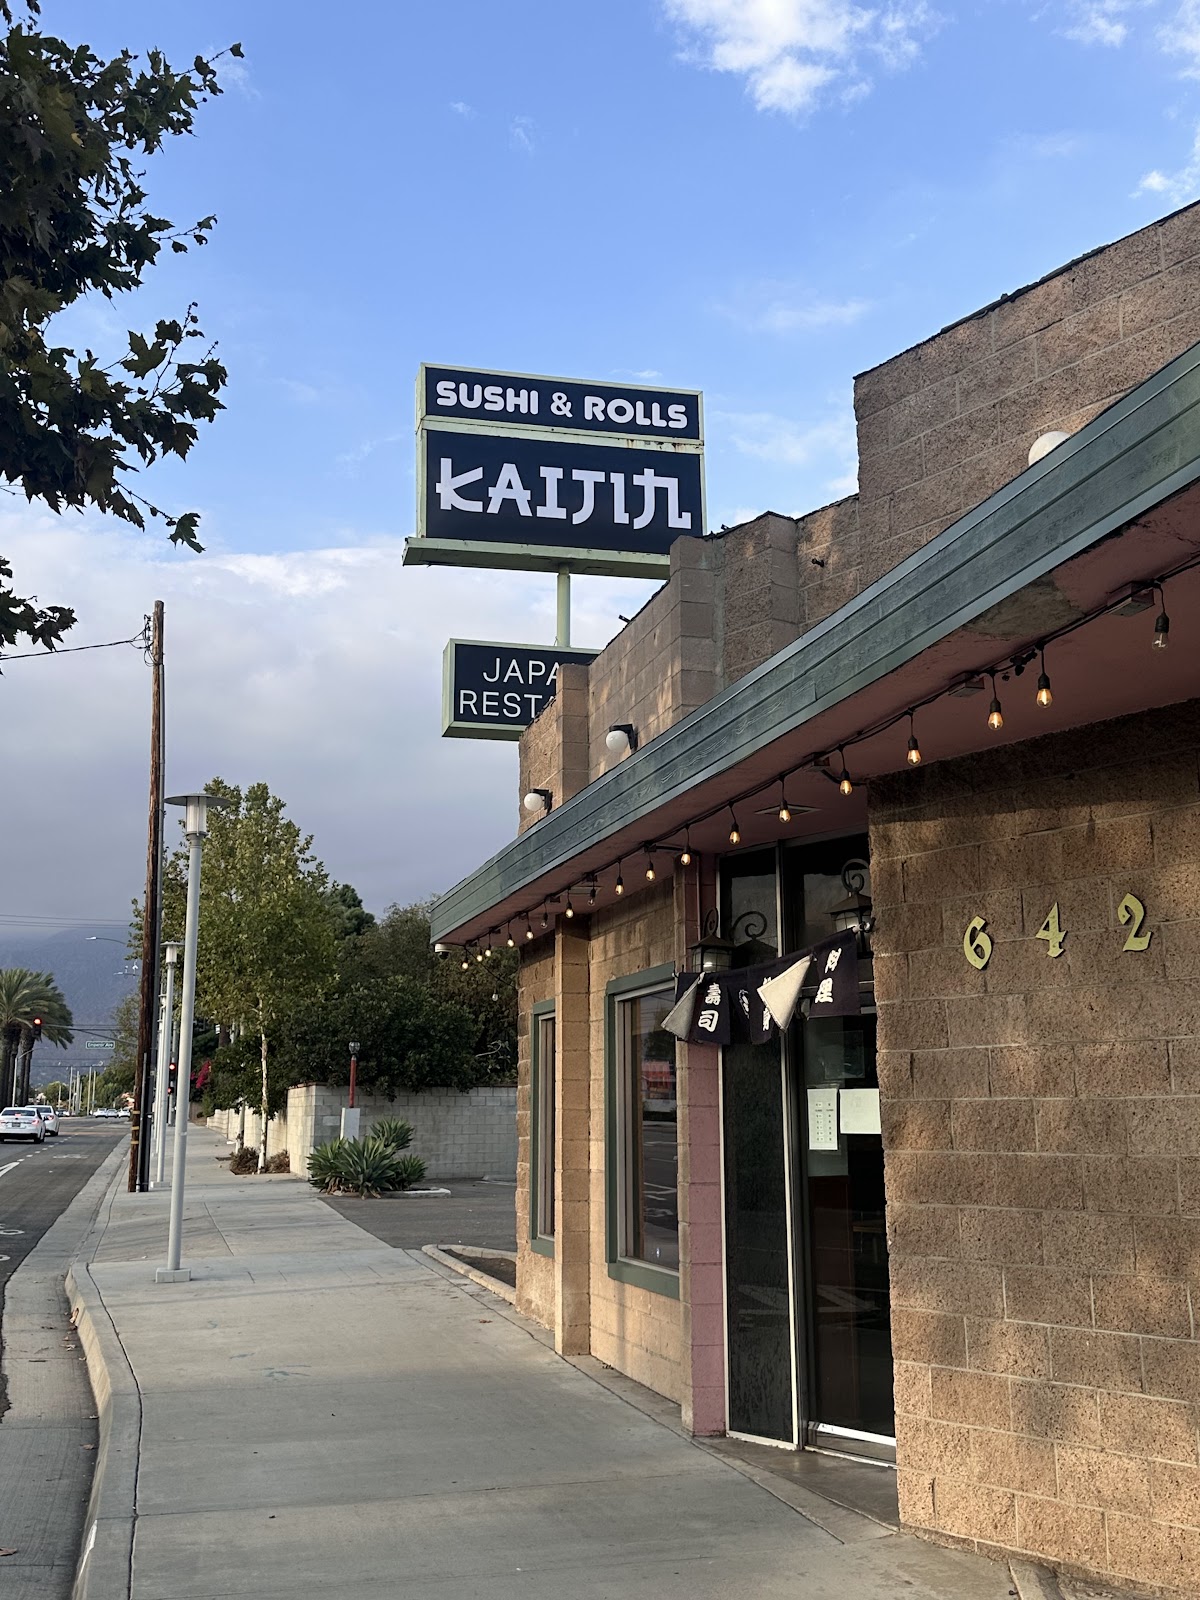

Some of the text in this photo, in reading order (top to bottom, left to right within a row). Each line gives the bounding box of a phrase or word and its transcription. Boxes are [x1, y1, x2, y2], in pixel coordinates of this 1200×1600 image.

[436, 380, 688, 429] SUSHI & ROLLS
[459, 689, 556, 719] REST
